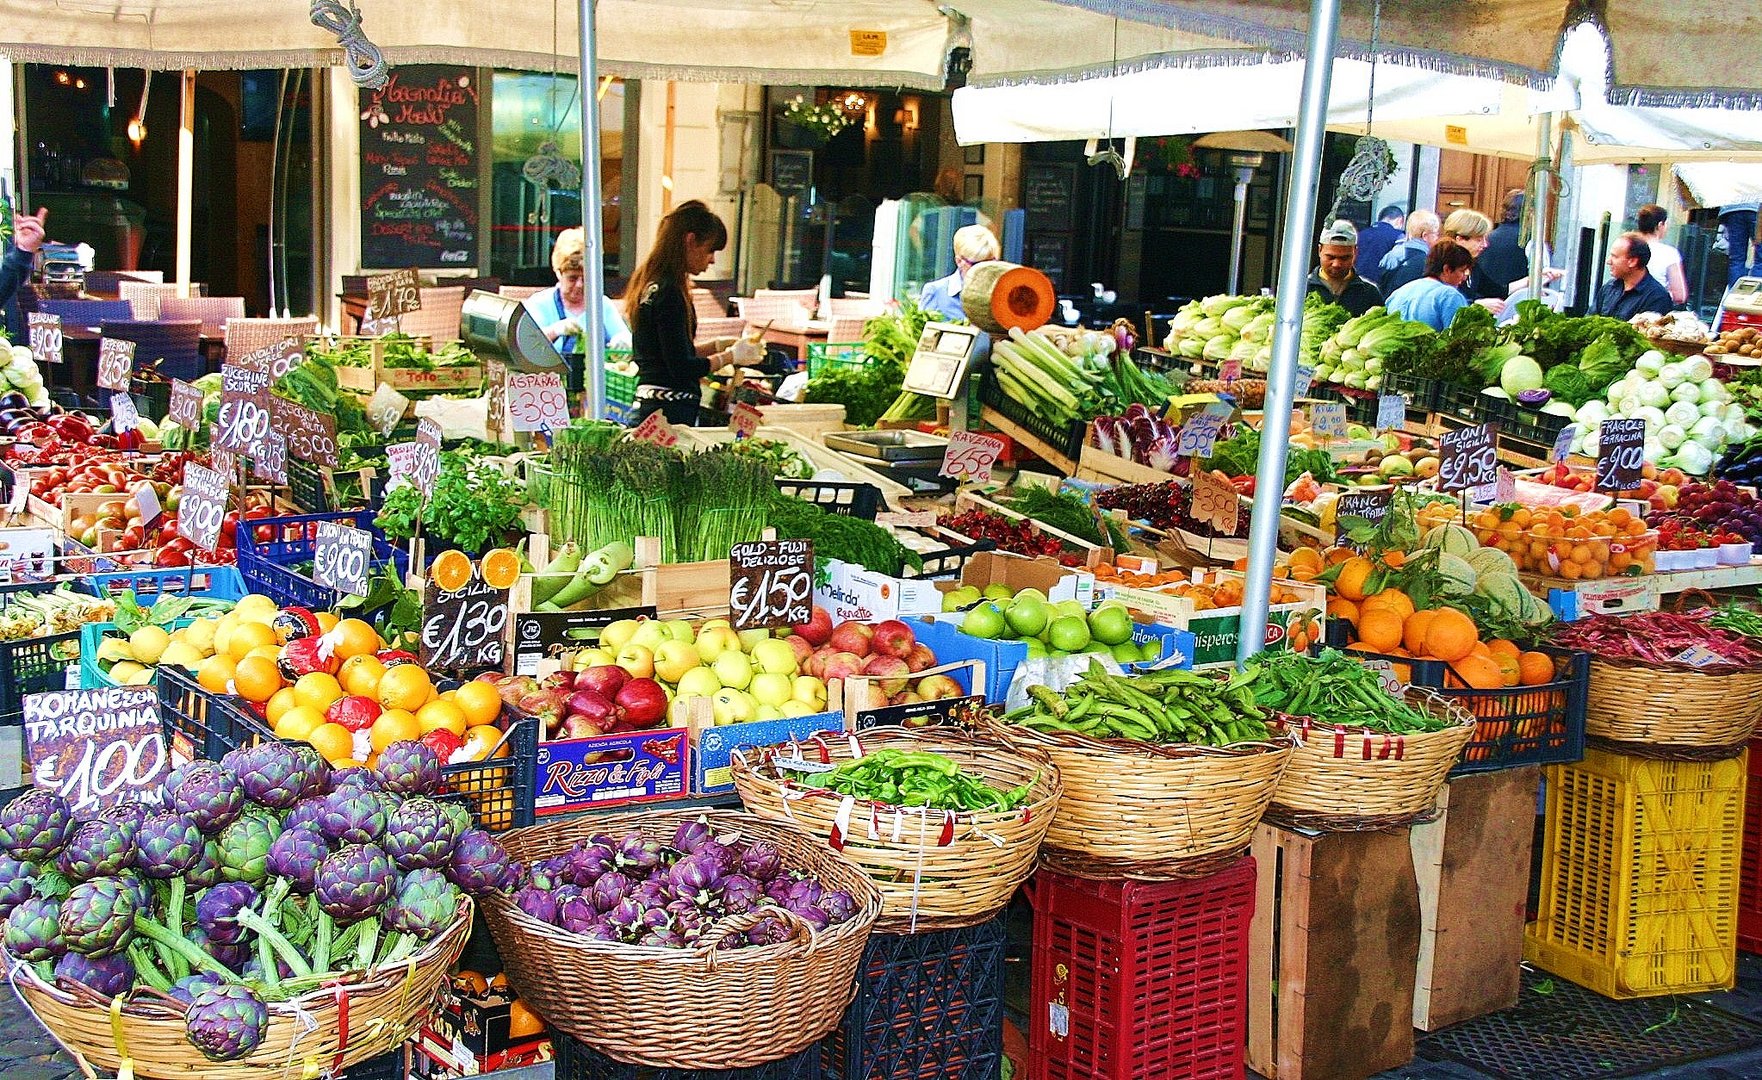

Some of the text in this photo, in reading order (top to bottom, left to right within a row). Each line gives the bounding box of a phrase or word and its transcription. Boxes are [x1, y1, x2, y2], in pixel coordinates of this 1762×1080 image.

[103, 338, 135, 354] PEPERONI
[241, 337, 299, 365] CAVOLFIORI
[221, 365, 270, 388] ZUCCHINE
[1440, 424, 1487, 446] MELONI
[1455, 434, 1490, 453] SICILIA
[731, 543, 768, 562] GOLD
[778, 541, 807, 555] FUJI
[741, 554, 805, 568] DELIZIOSE
[786, 605, 810, 624] KG
[476, 640, 501, 665] KG
[25, 706, 160, 743] TARQUINIA
[608, 764, 628, 783] &
[626, 759, 666, 787] Figli
